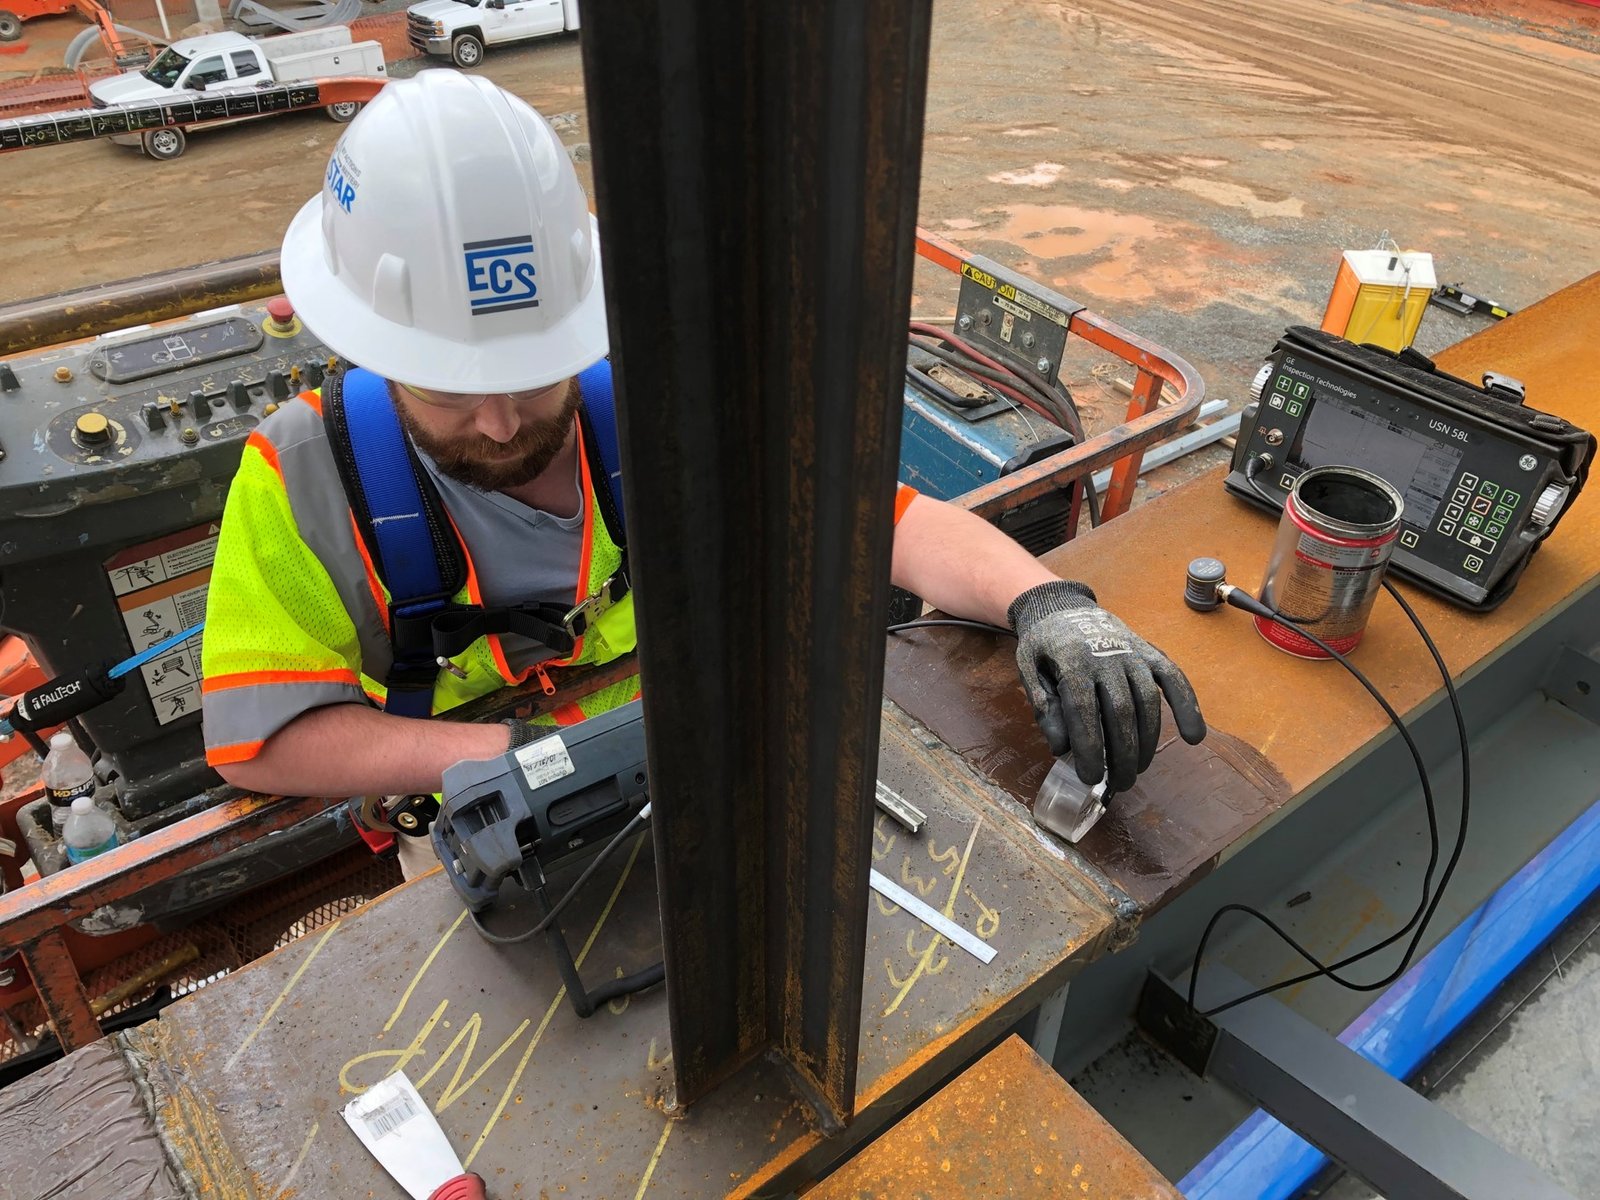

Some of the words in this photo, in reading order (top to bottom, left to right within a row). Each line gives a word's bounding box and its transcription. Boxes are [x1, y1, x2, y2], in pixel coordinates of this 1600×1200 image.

[327, 158, 355, 214] STAR
[465, 245, 537, 306] ECS
[1286, 357, 1295, 365] GE
[1283, 365, 1315, 381] Inspection
[1316, 377, 1357, 399] Technologies
[1429, 419, 1450, 434] USN
[1451, 428, 1469, 443] 58L
[40, 681, 81, 706] FALLTECH
